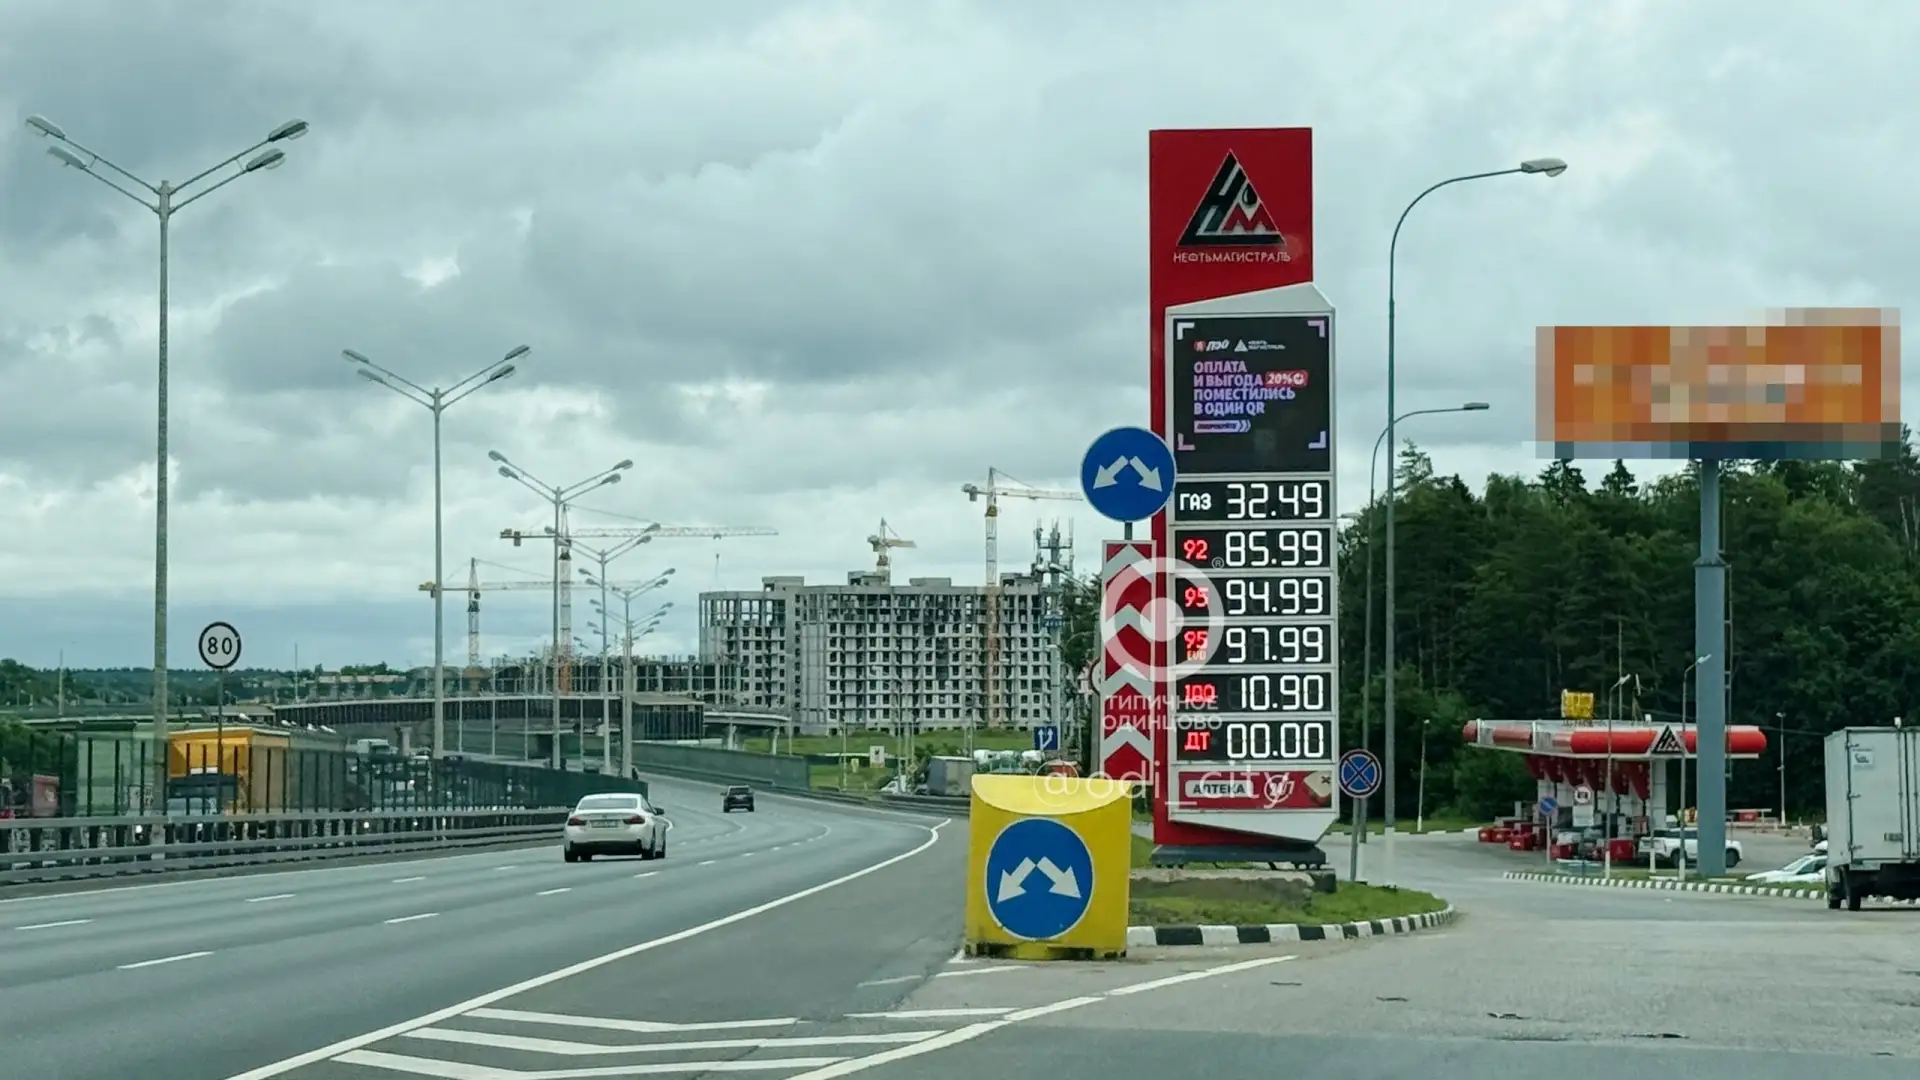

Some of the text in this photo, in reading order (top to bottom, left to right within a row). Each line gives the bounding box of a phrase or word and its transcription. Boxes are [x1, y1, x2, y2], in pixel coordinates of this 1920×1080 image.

[1173, 251, 1291, 263] НЕФТЬМАГИСТРАЛЬ
[1193, 360, 1247, 374] ОПЛАТА
[1193, 373, 1293, 389] И ВЫГОДА 20%
[1193, 387, 1297, 401] ПОМЕСТИЛИСЬ
[1193, 401, 1265, 417] В ОДИН QR
[1179, 482, 1323, 519] ГАЗ 32.49
[1183, 530, 1323, 567] 92 85.99
[1184, 578, 1323, 615] 95 94.99
[207, 636, 232, 655] 80
[1183, 627, 1324, 663] 95 97.99
[1184, 674, 1324, 711] 100 10.90
[1183, 722, 1324, 759] ДТ 00.00
[1192, 783, 1246, 794] АПТЕКА
